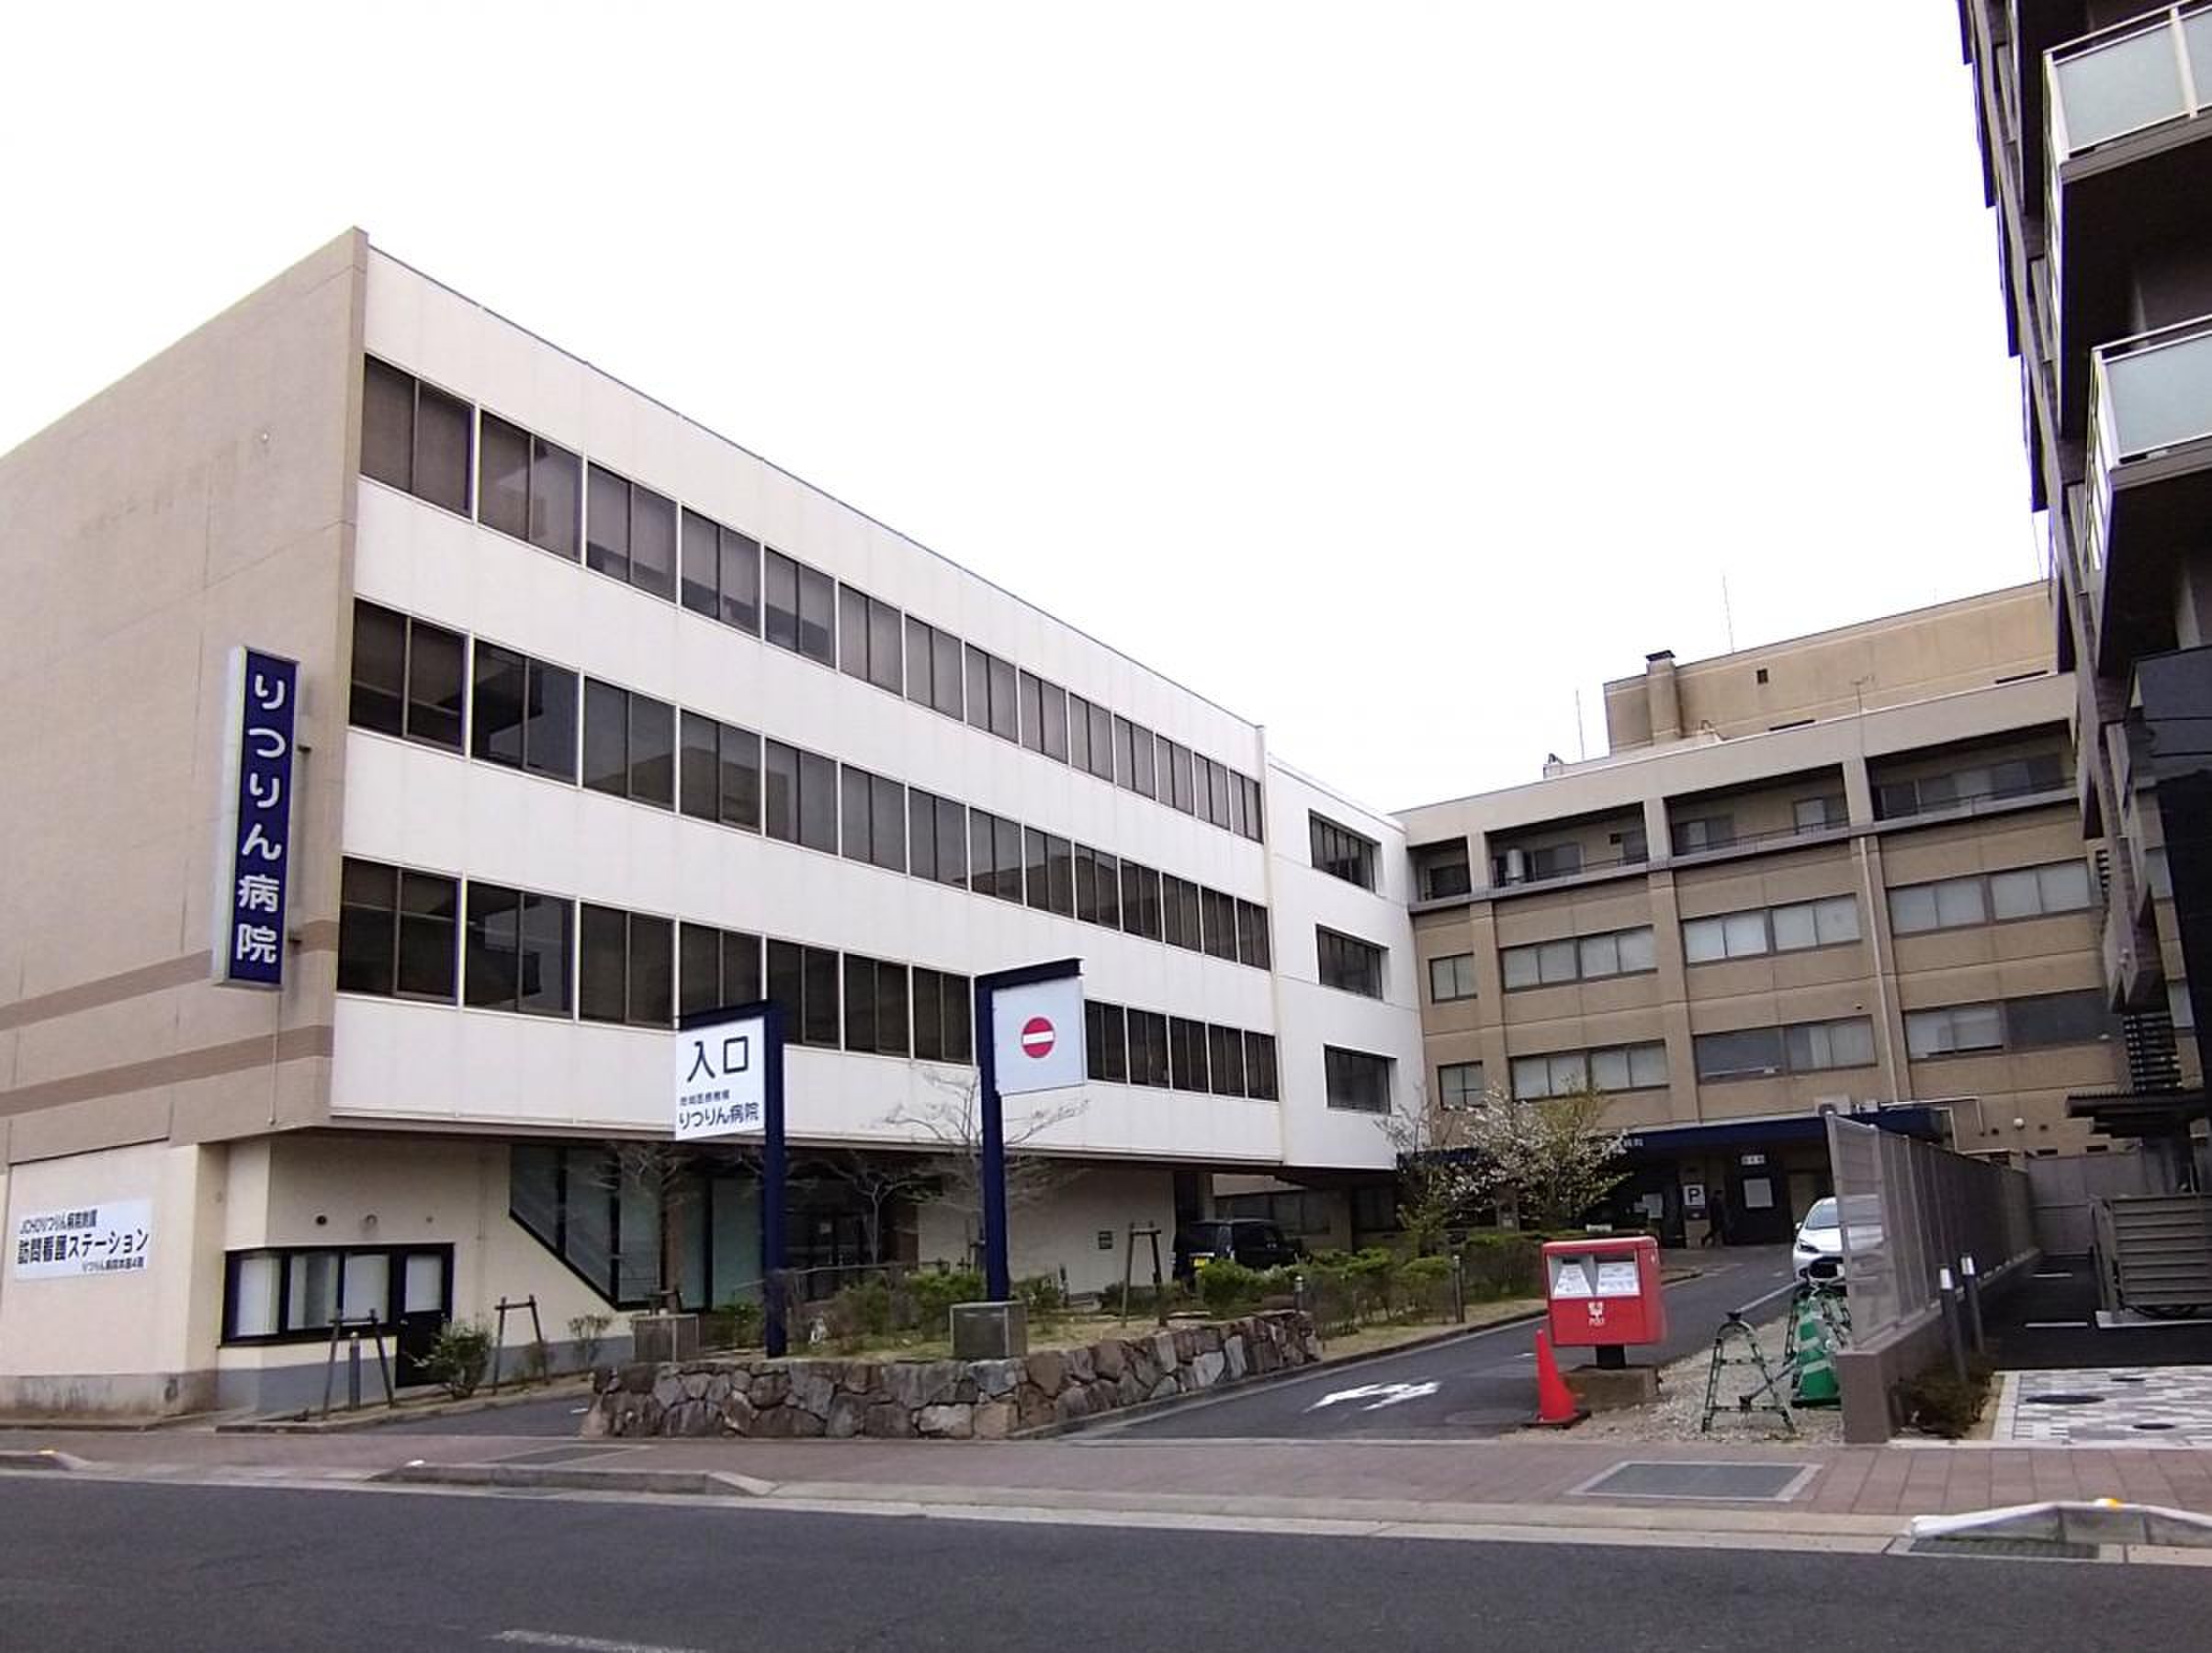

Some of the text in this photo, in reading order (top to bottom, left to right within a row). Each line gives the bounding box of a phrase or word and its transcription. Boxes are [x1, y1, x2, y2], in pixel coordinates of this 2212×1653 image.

[235, 674, 286, 962] りつりん病院
[687, 1036, 749, 1082] 入口
[679, 1102, 760, 1130] りつりん病院
[1688, 1187, 1701, 1203] P
